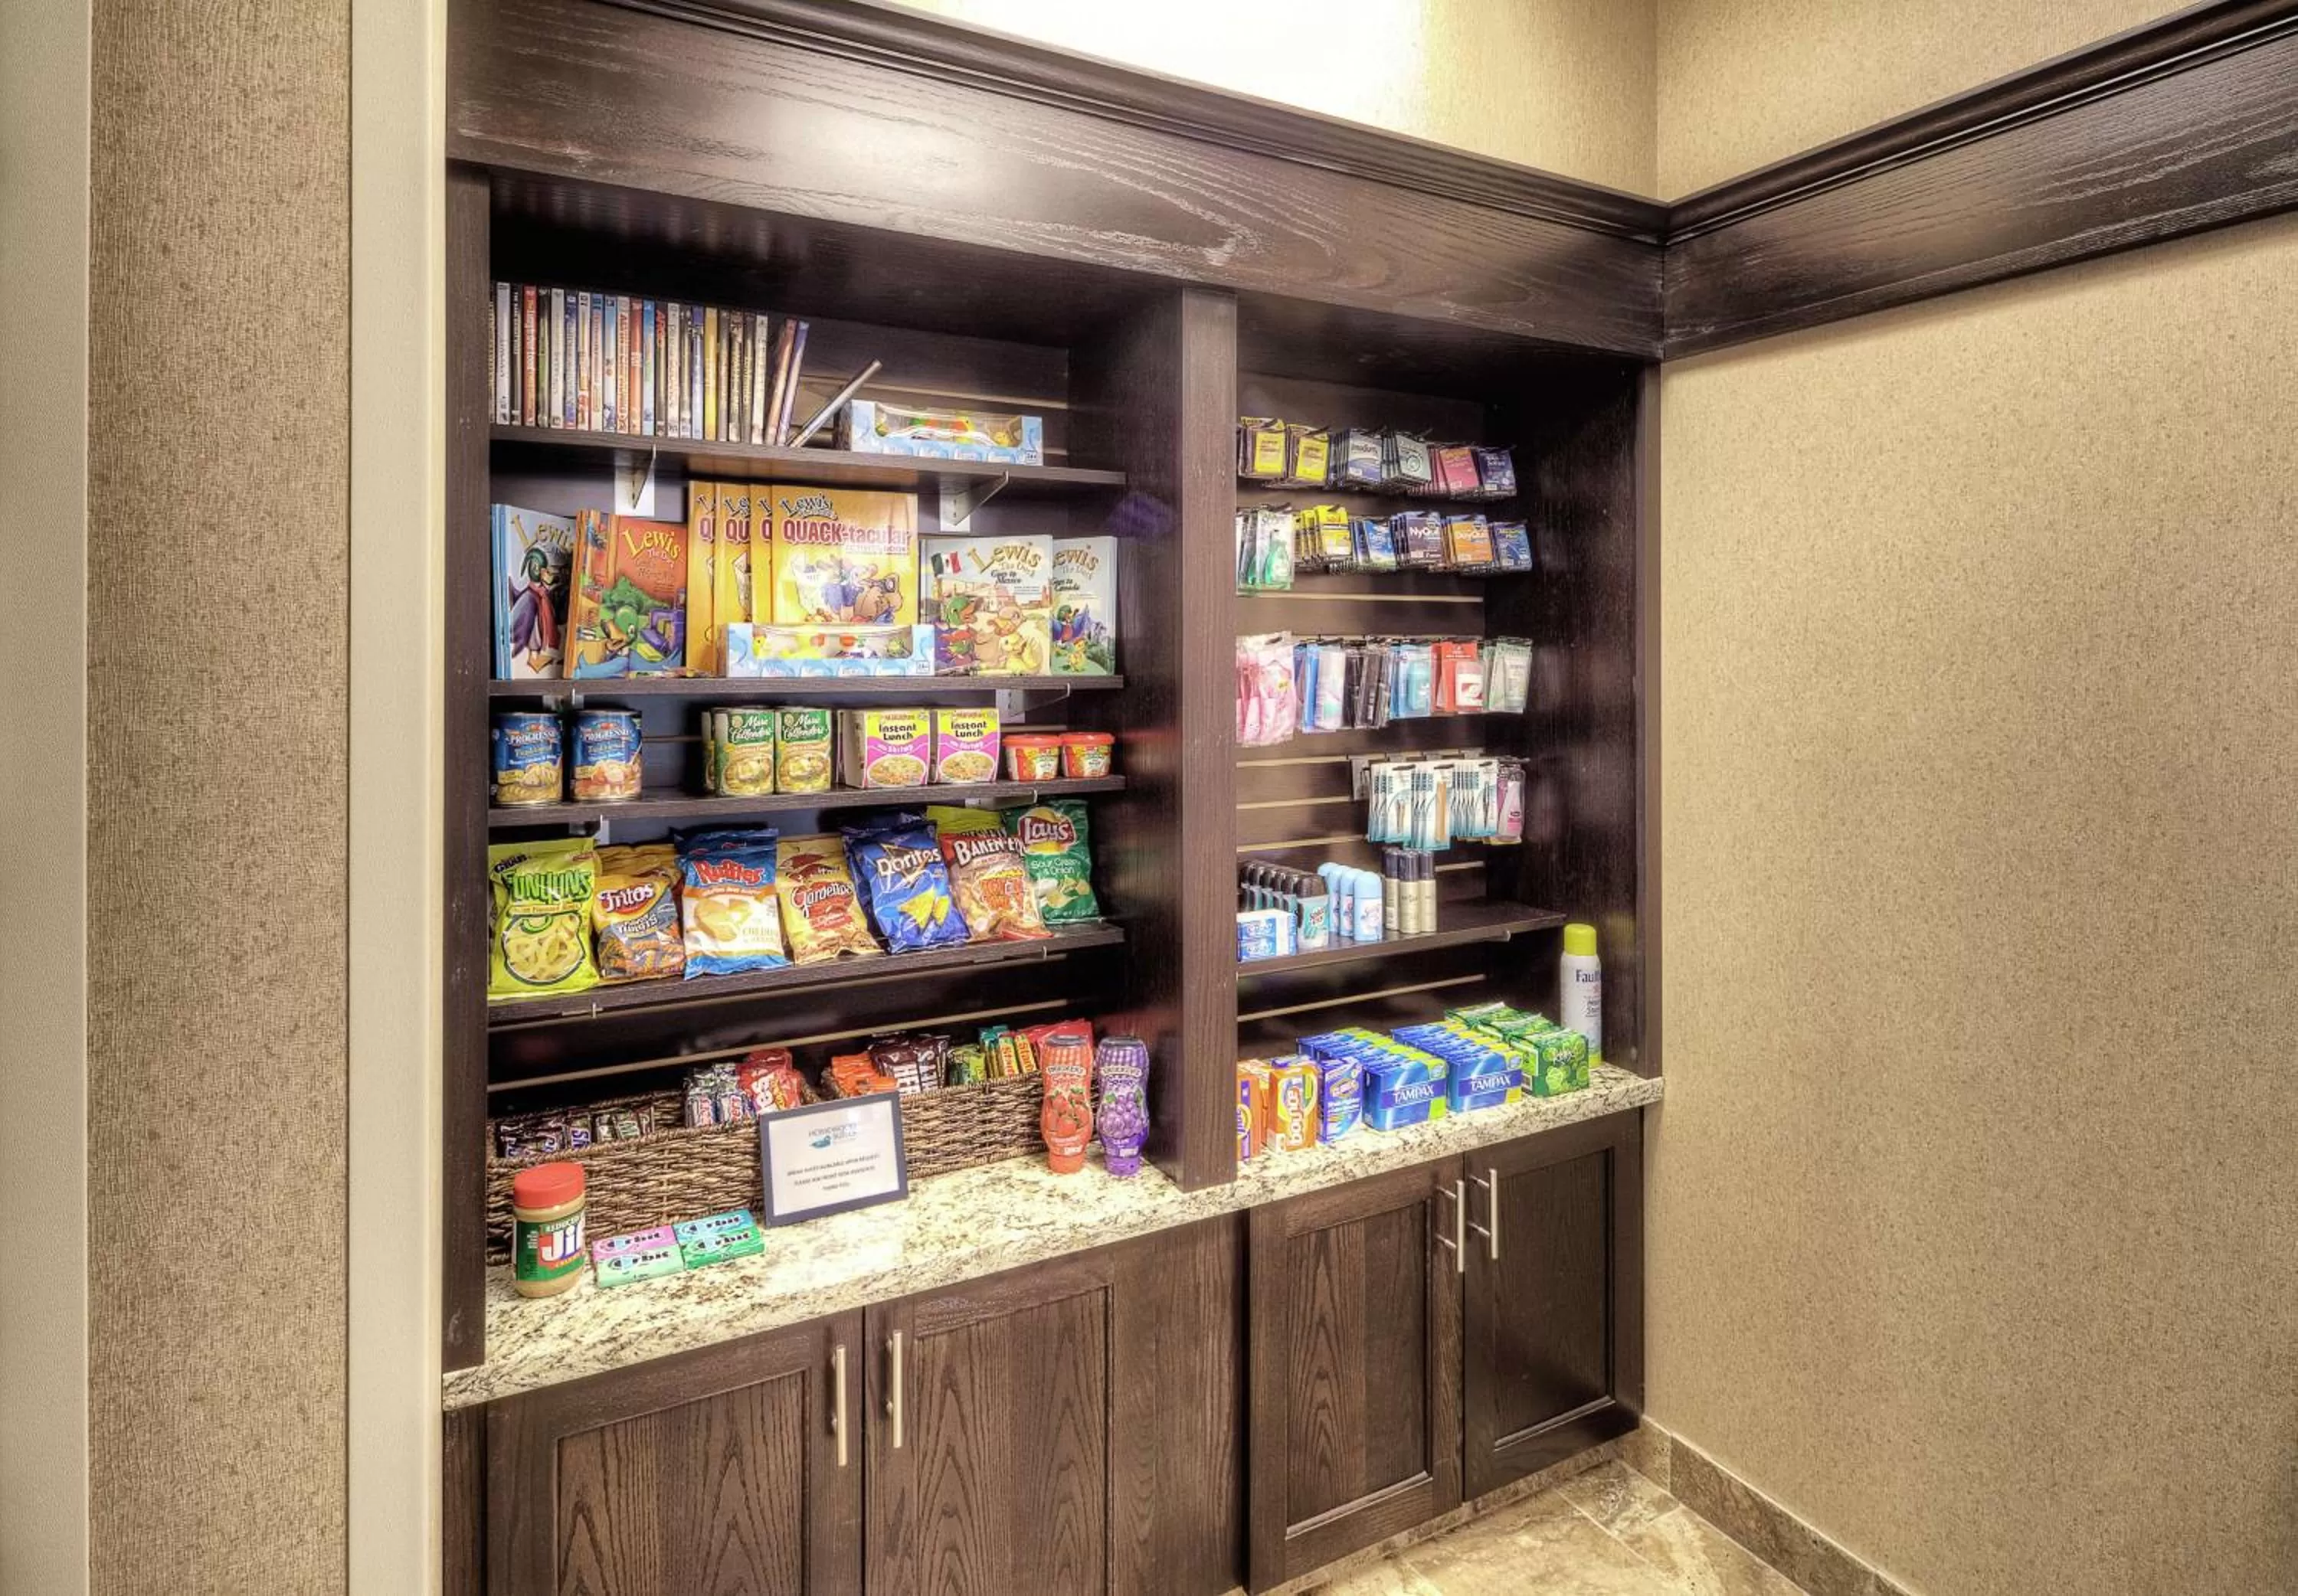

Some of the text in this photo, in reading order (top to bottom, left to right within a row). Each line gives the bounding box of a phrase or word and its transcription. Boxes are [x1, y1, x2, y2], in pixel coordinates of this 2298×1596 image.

[621, 527, 681, 560] Lewis
[967, 541, 1043, 574] Lewis
[1051, 545, 1100, 571] ewis
[879, 722, 917, 733] Instant
[883, 732, 914, 741] Lunch
[951, 720, 987, 730] Instant
[691, 859, 764, 886] Ruffles
[876, 848, 941, 877] Doritos
[597, 883, 655, 912] Fritos
[1393, 1084, 1435, 1105] TAMPAX
[1470, 1073, 1512, 1091] TAMPAX
[1288, 1085, 1304, 1146] bounce
